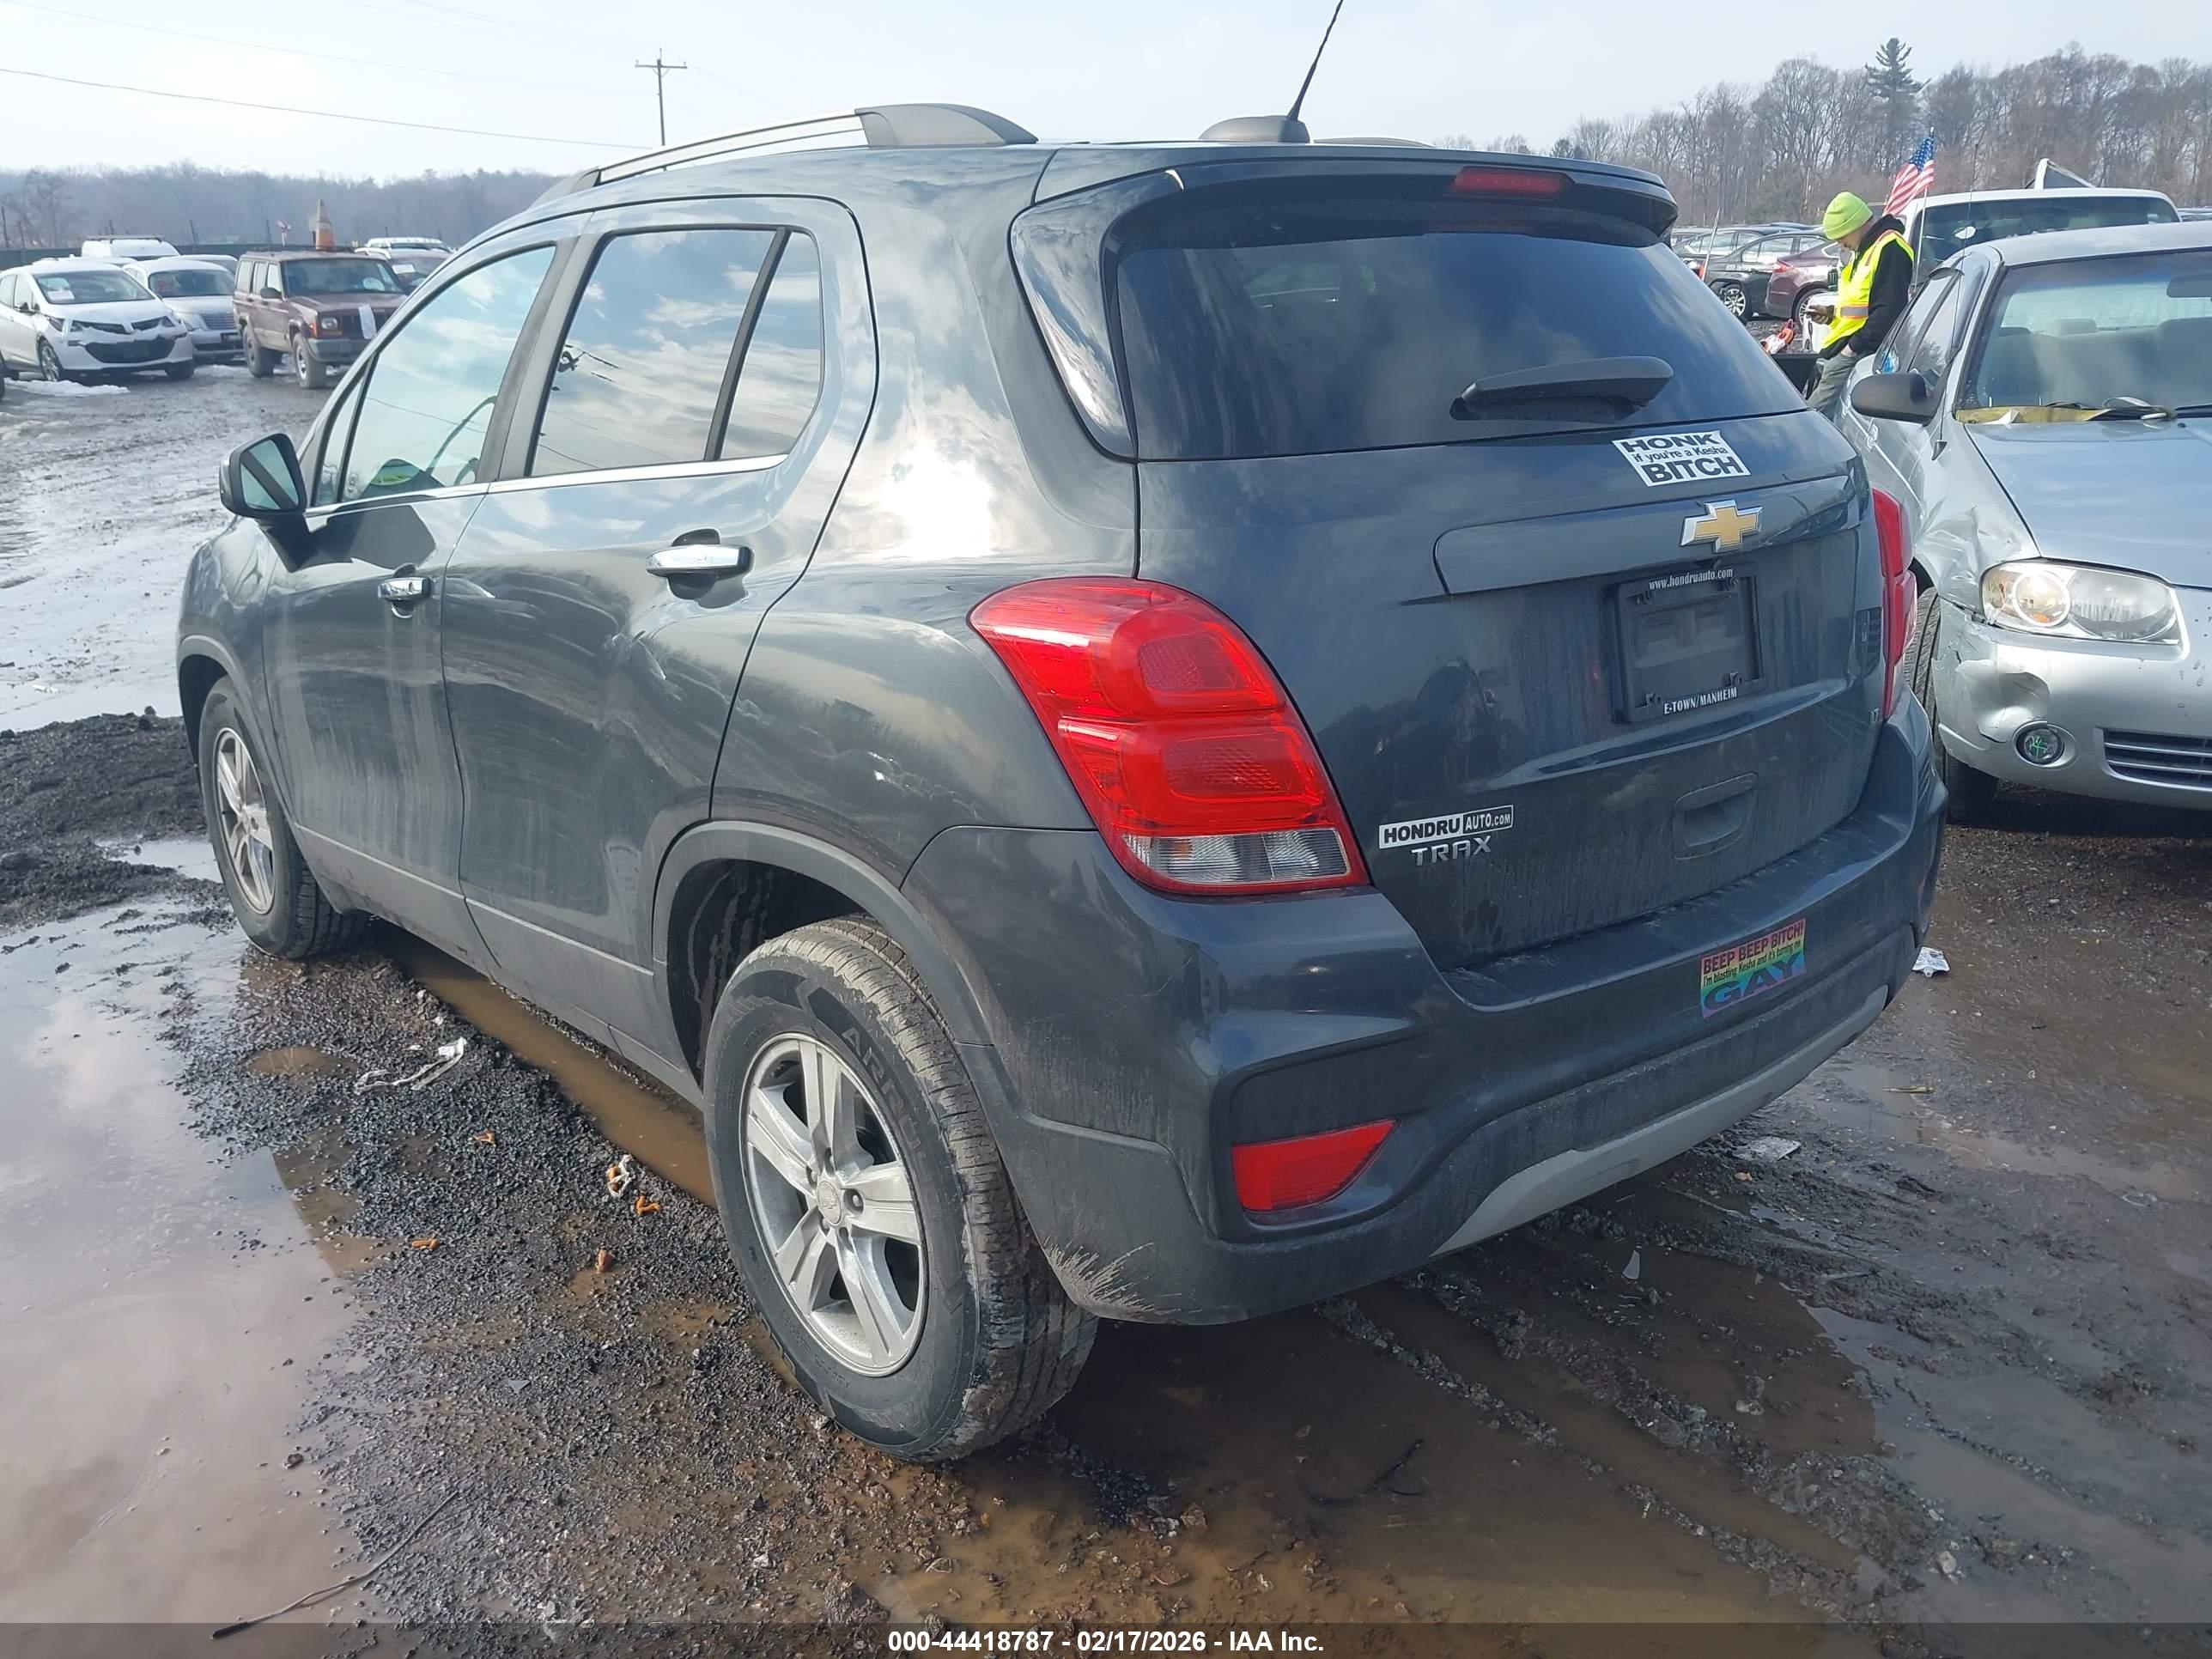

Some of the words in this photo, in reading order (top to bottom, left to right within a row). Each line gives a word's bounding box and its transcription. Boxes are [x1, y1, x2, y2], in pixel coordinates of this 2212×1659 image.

[1620, 434, 1721, 453] HONK
[1632, 453, 1642, 462] if
[1645, 449, 1683, 463] you're
[1694, 446, 1729, 456] Kesha
[1640, 456, 1744, 483] BITCH
[1649, 568, 1733, 591] www.hondruauto.com
[1663, 687, 1737, 714] E-TOWN/MANHEIM
[1383, 817, 1461, 844] HONDRU
[1411, 835, 1492, 866] TRAX
[1703, 951, 1735, 975] BEEP
[1738, 936, 1769, 963] BEEP
[1704, 951, 1802, 1011] GAY
